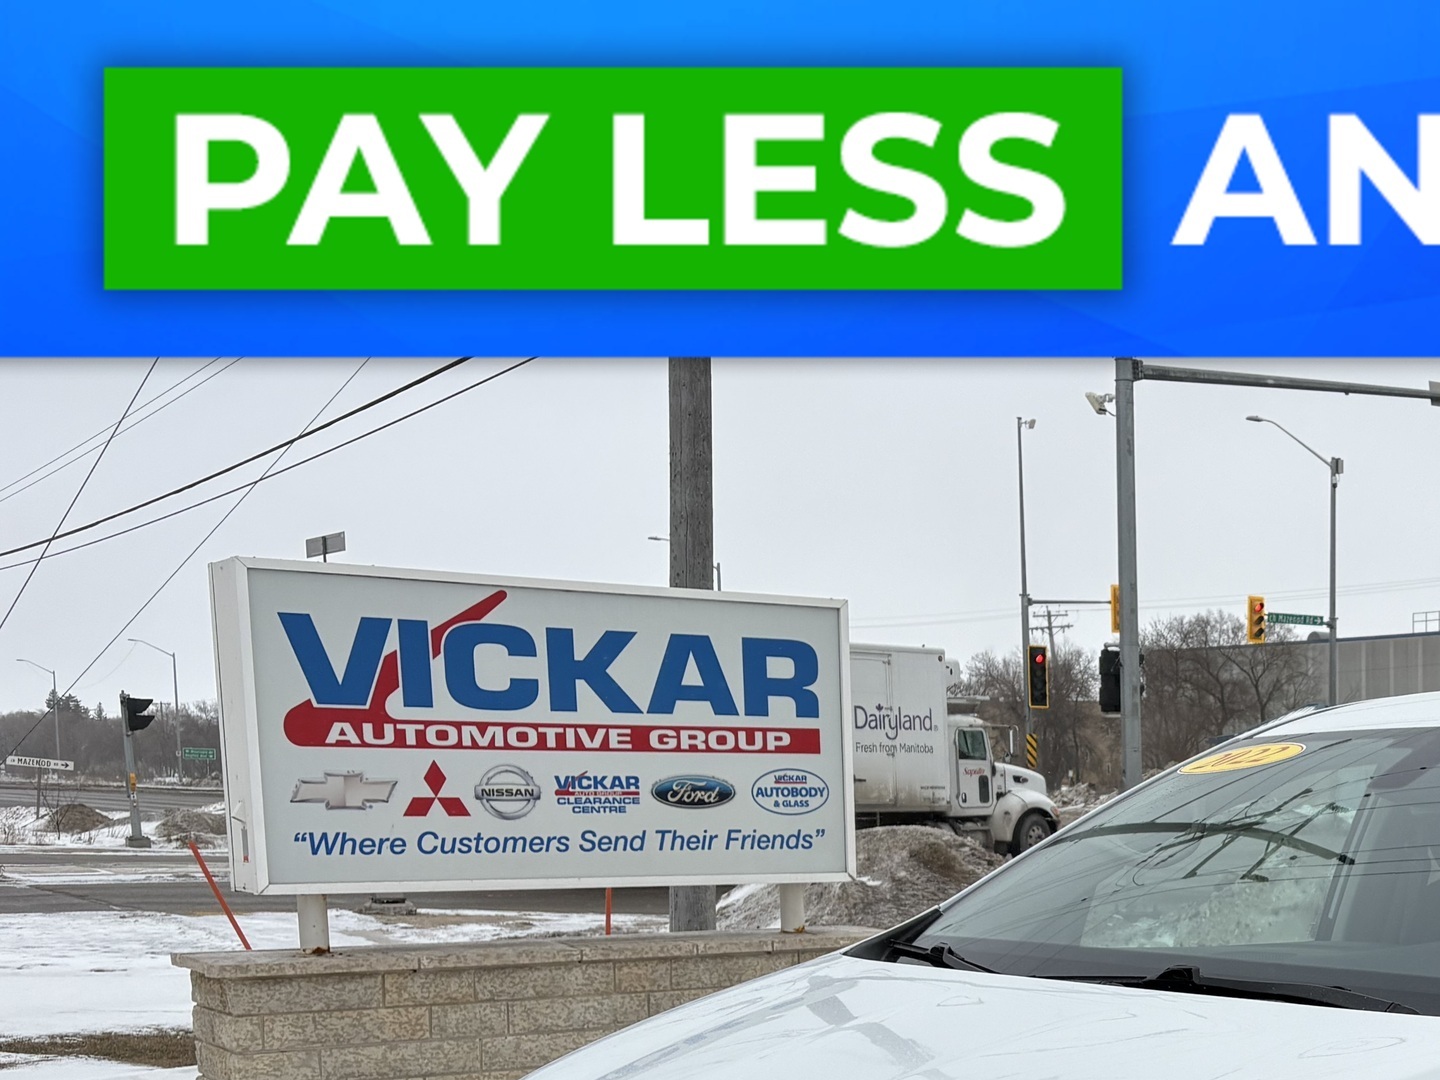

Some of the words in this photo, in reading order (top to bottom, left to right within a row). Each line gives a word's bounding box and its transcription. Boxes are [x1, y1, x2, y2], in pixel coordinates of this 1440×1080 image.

[277, 611, 820, 719] VICKAR
[854, 704, 934, 741] Dairyland
[324, 721, 632, 750] AUTOMOTIVE
[649, 729, 792, 751] GROUP
[855, 741, 878, 754] Fresh
[879, 742, 898, 754] from
[899, 742, 934, 754] Manitoba
[17, 757, 52, 768] MAZENOD
[554, 775, 640, 790] VICKAR
[774, 774, 808, 782] VICKAR
[480, 788, 534, 797] NISSAN
[667, 779, 720, 803] Ford
[755, 786, 826, 798] AUTOBODY
[556, 797, 641, 805] CLEARANCE
[773, 800, 780, 808] &
[782, 799, 810, 808] GLASS
[571, 805, 627, 814] CENTRE
[417, 830, 570, 855] Customers
[578, 829, 647, 853] Send
[655, 829, 719, 851] Their
